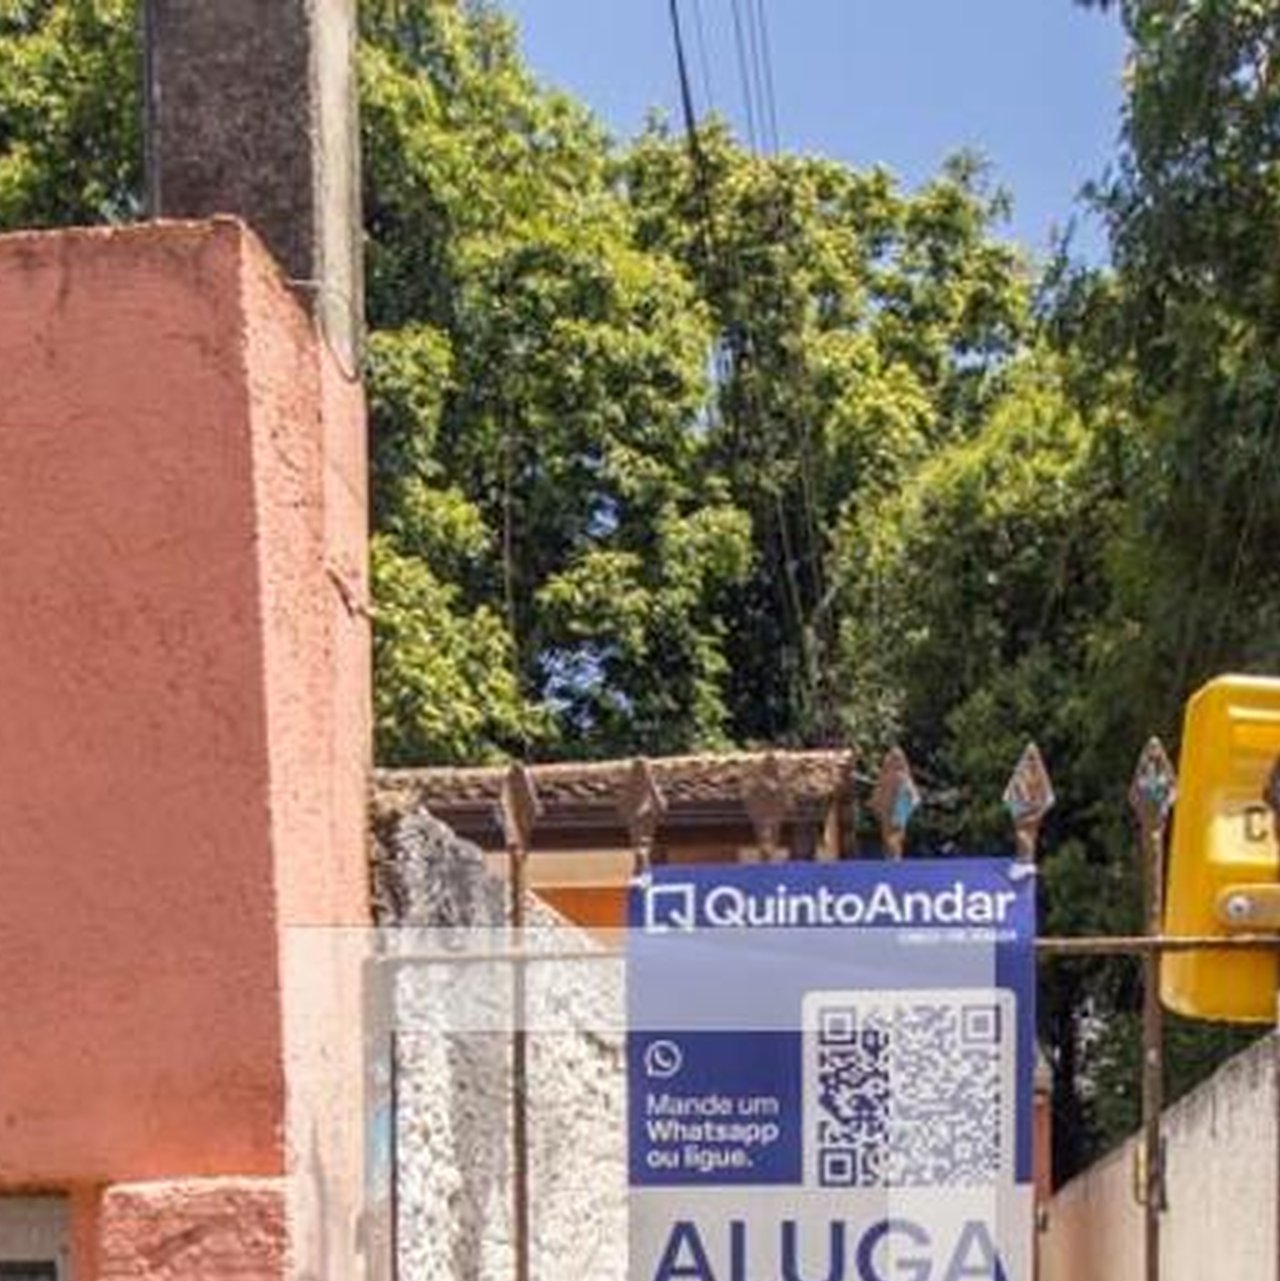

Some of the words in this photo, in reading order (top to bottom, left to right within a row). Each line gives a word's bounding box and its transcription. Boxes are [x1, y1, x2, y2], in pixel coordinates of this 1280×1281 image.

[705, 883, 1017, 926] QuintoAndar
[646, 1093, 733, 1116] Mande
[737, 1097, 780, 1115] um
[646, 1119, 780, 1146] Whatsapp
[646, 1149, 680, 1168] ou
[684, 1144, 754, 1172] ligue.
